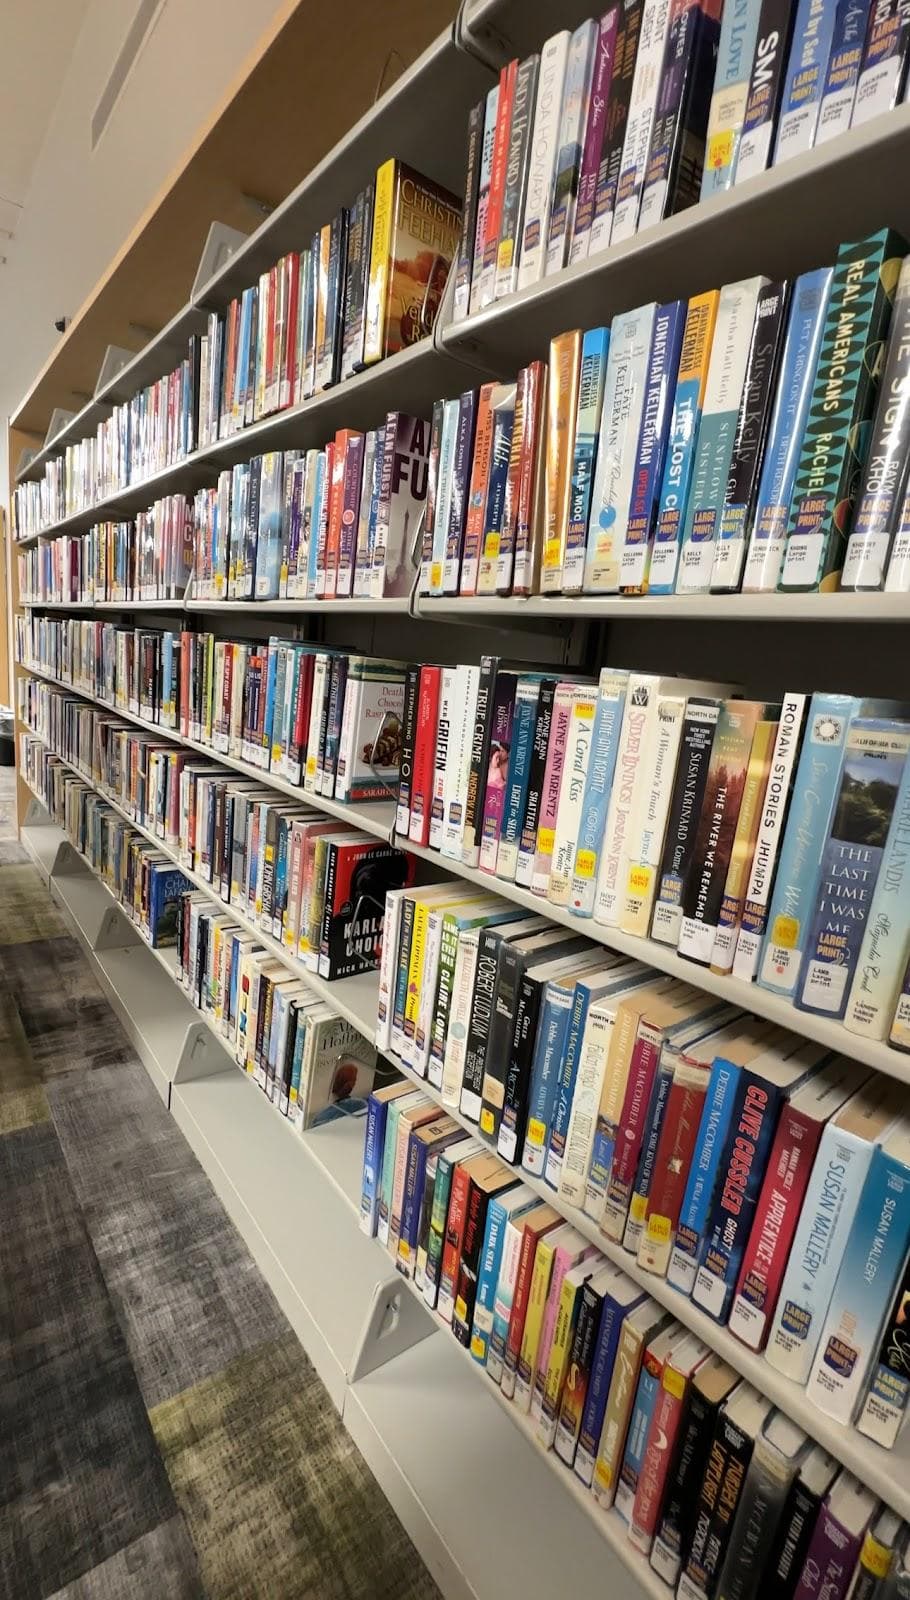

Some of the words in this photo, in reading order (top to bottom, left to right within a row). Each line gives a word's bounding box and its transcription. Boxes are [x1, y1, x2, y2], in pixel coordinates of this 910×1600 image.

[641, 6, 656, 50] SIGHT
[871, 15, 900, 42] LARGE
[726, 23, 746, 80] LOVE
[832, 48, 861, 71] LARGE
[868, 35, 893, 57] PRINT
[514, 61, 534, 115] LINDA
[540, 64, 556, 121] LINDA
[793, 67, 818, 88] LARGE
[829, 67, 853, 87] PRINT
[507, 115, 528, 187] HOWARD
[530, 124, 553, 210] HOWARD
[842, 259, 865, 307] REAL
[649, 315, 669, 385] JONATHAN
[680, 307, 699, 373] KELLERMAN
[749, 344, 772, 403] Susan
[823, 312, 857, 412] AMERICANS
[580, 354, 594, 410] KELLERMAN
[608, 364, 627, 446] KELLERMAN
[620, 388, 634, 421] FAYE
[384, 412, 398, 454] ALAN
[640, 386, 661, 465] KELLERMAN
[737, 407, 761, 463] Kelly
[380, 454, 393, 502] FURST
[576, 461, 587, 491] HALF
[668, 438, 687, 487] LOST
[693, 442, 711, 510] SISTERS
[807, 432, 833, 497] RACHEL
[660, 511, 679, 523] LARGE
[694, 511, 716, 524] LARGE
[798, 515, 820, 527] PRINT
[801, 500, 826, 513] LARGE
[628, 519, 648, 530] LARGE
[692, 524, 711, 535] PRINT
[407, 688, 415, 723] STEPHEN
[477, 688, 489, 720] TRUE
[521, 704, 531, 728] JAYNE
[688, 711, 707, 719] NORTH
[405, 724, 413, 740] KING
[519, 728, 529, 742] ANN
[534, 717, 543, 751] KRENTZ
[543, 710, 551, 738] JAYNE
[555, 712, 568, 746] JAYNE
[579, 722, 591, 733] A
[599, 708, 615, 738] JAYNE
[627, 711, 646, 754] SILVER
[776, 702, 797, 758] ROMAN
[436, 720, 450, 771] GRIFFIN
[472, 724, 485, 763] CRIME
[515, 742, 527, 777] KRENTZ
[539, 739, 548, 760] ANN
[574, 739, 588, 776] Coral
[552, 749, 563, 774] ANN
[591, 760, 608, 793] KRENTZ
[620, 753, 640, 803] LININGS
[686, 752, 702, 786] SUSAN
[466, 770, 478, 806] ANDREW
[510, 784, 521, 808] LIGHT
[546, 775, 559, 818] KRENTZ
[569, 779, 584, 802] Kiss
[716, 787, 727, 809] THE
[764, 764, 785, 828] STORIES
[647, 790, 662, 820] Touch
[677, 790, 696, 840] KRINARD
[708, 814, 723, 847] RIVER
[672, 845, 685, 870] Come
[704, 850, 717, 868] WE
[751, 839, 771, 896] JHUMPA
[839, 847, 872, 862] THE
[832, 865, 870, 881] LAST
[826, 882, 868, 901] TIME
[404, 902, 413, 923] LADY
[743, 912, 761, 926] PRINT
[745, 901, 766, 916] LARGE
[820, 901, 825, 911] I
[831, 902, 865, 920] WAS
[816, 946, 841, 958] PRINT
[819, 933, 848, 947] LARGE
[337, 964, 355, 975] NICK
[401, 947, 410, 968] LAKE
[814, 968, 829, 976] LAMB
[439, 970, 450, 1009] CLAIRE
[477, 954, 497, 997] ROBERT
[812, 973, 831, 982] Large
[472, 995, 493, 1040] LUDLUM
[572, 991, 585, 1028] DEBBIE
[589, 1013, 609, 1023] NORTH
[546, 1020, 558, 1043] Debbie
[541, 1046, 554, 1080] Macomber
[562, 1030, 579, 1089] MACOMBER
[506, 1060, 520, 1104] ARCTIC
[628, 1070, 648, 1126] MACOMBER
[659, 1079, 669, 1098] Debbie
[713, 1069, 730, 1108] DEBBIE
[368, 1114, 376, 1133] SUSAN
[653, 1100, 666, 1130] Macomber
[738, 1084, 769, 1142] CLIVE
[366, 1134, 375, 1161] MALLERY
[650, 1132, 658, 1147] SOME
[699, 1110, 721, 1171] MACOMBER
[407, 1167, 417, 1199] MALLERY
[721, 1136, 757, 1216] CUSSLER
[818, 1160, 846, 1212] SUSAN
[756, 1189, 788, 1265] APPRENTICE
[877, 1197, 897, 1233] SUSAN
[488, 1221, 499, 1248] DARK
[723, 1217, 738, 1251] GHOST
[801, 1212, 834, 1279] MALLERY
[484, 1248, 497, 1273] STAR
[864, 1232, 888, 1286] MALLERY
[786, 1302, 811, 1323] LARGE
[777, 1330, 801, 1347] MALLERY
[830, 1338, 857, 1361] LARGE
[826, 1349, 848, 1368] PRINT
[819, 1369, 844, 1388] MALLERY
[701, 1439, 728, 1512] LAMPLIGHT
